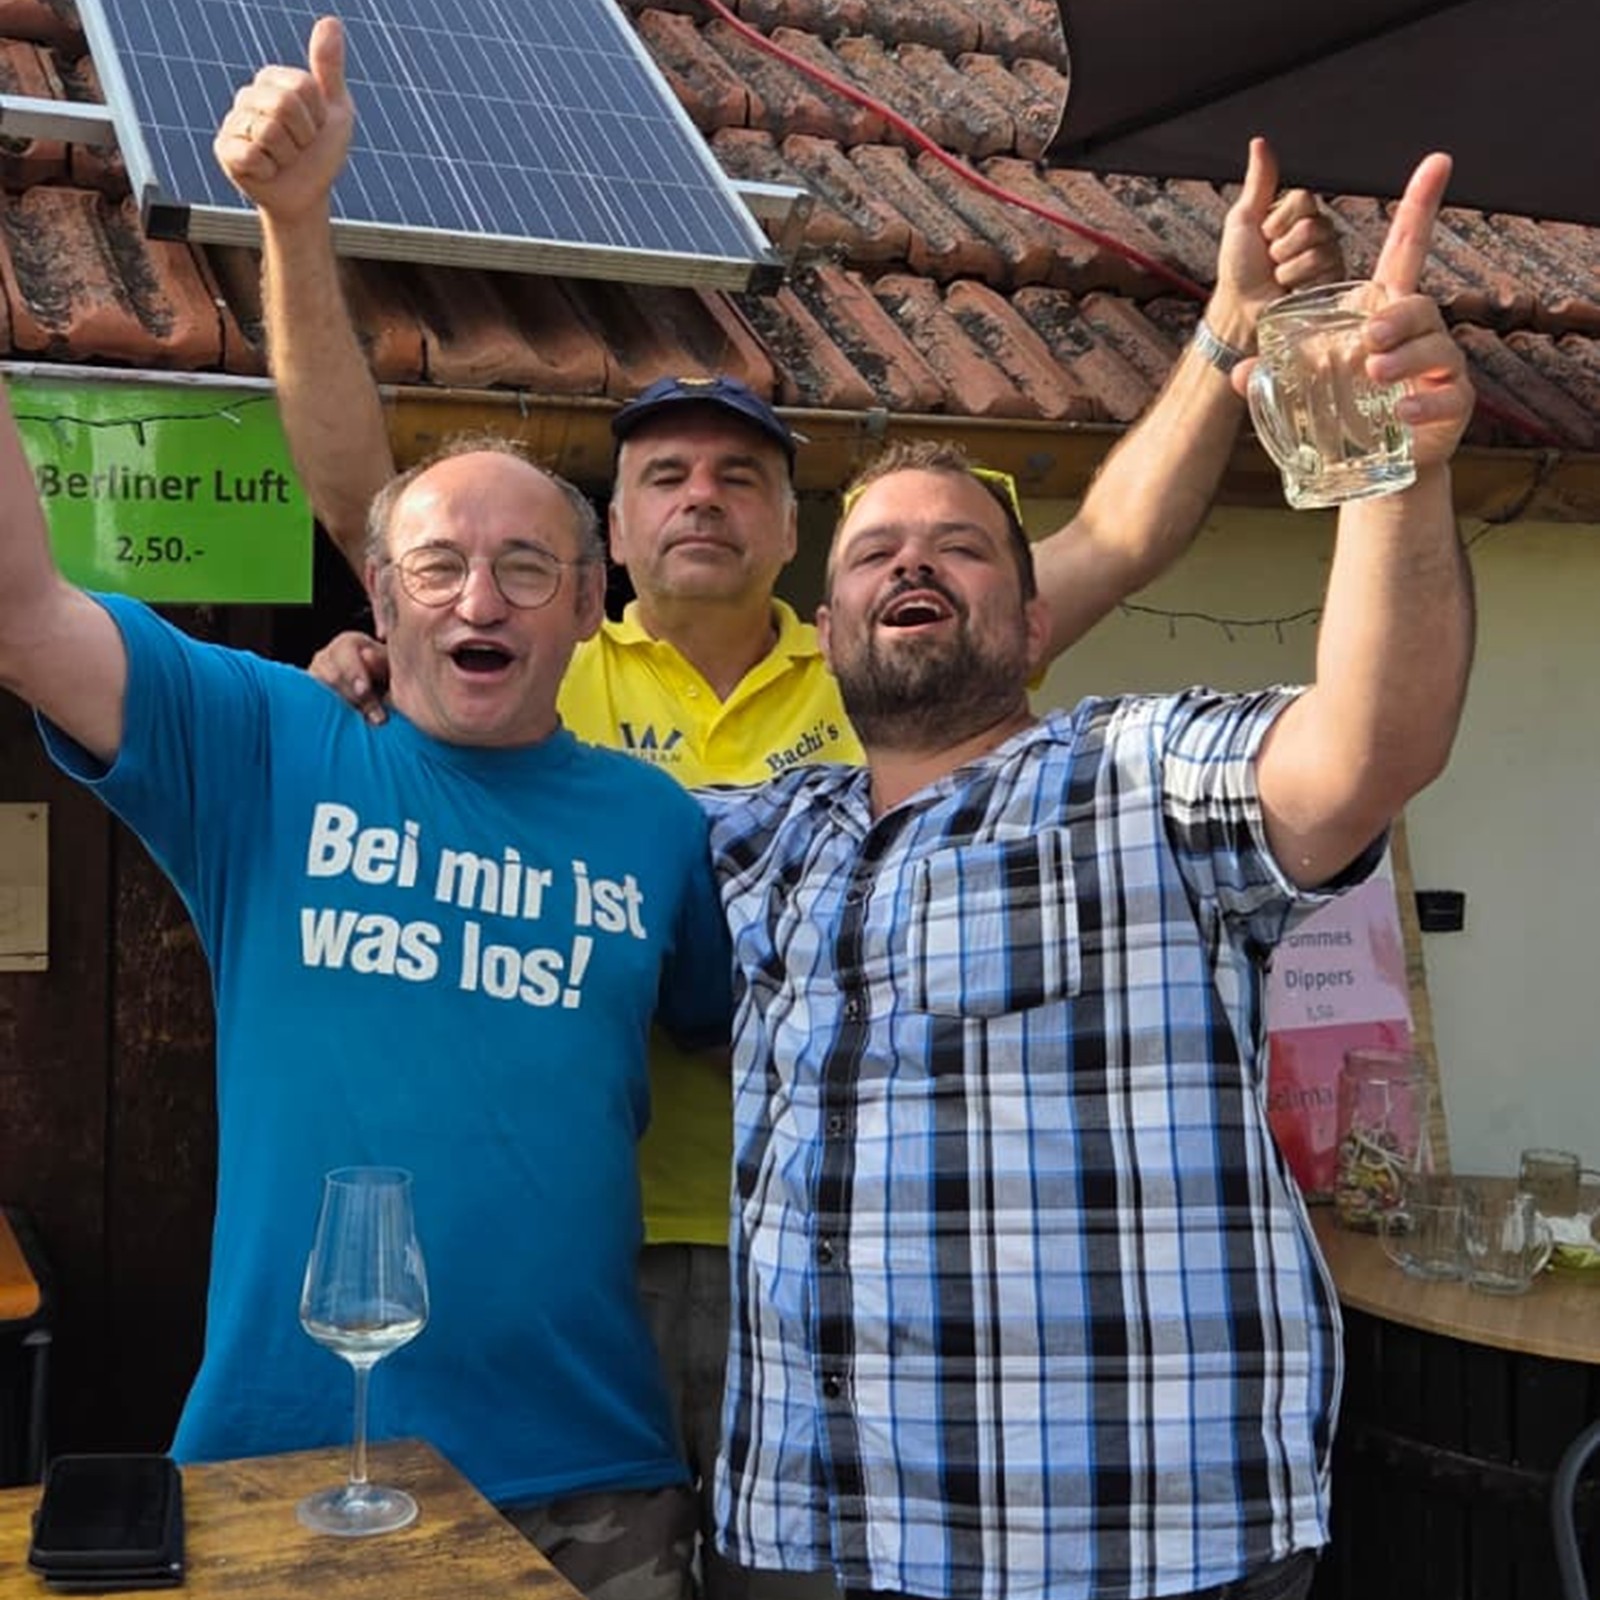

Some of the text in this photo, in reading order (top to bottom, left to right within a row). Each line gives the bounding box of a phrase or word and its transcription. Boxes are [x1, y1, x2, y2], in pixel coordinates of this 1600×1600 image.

[39, 465, 290, 503] Berliner Luft
[116, 536, 205, 567] 2,50.-
[306, 802, 647, 940] Bei mir ist
[1280, 931, 1353, 949] ommes
[301, 908, 594, 1010] was los!
[1285, 969, 1355, 991] Dippers
